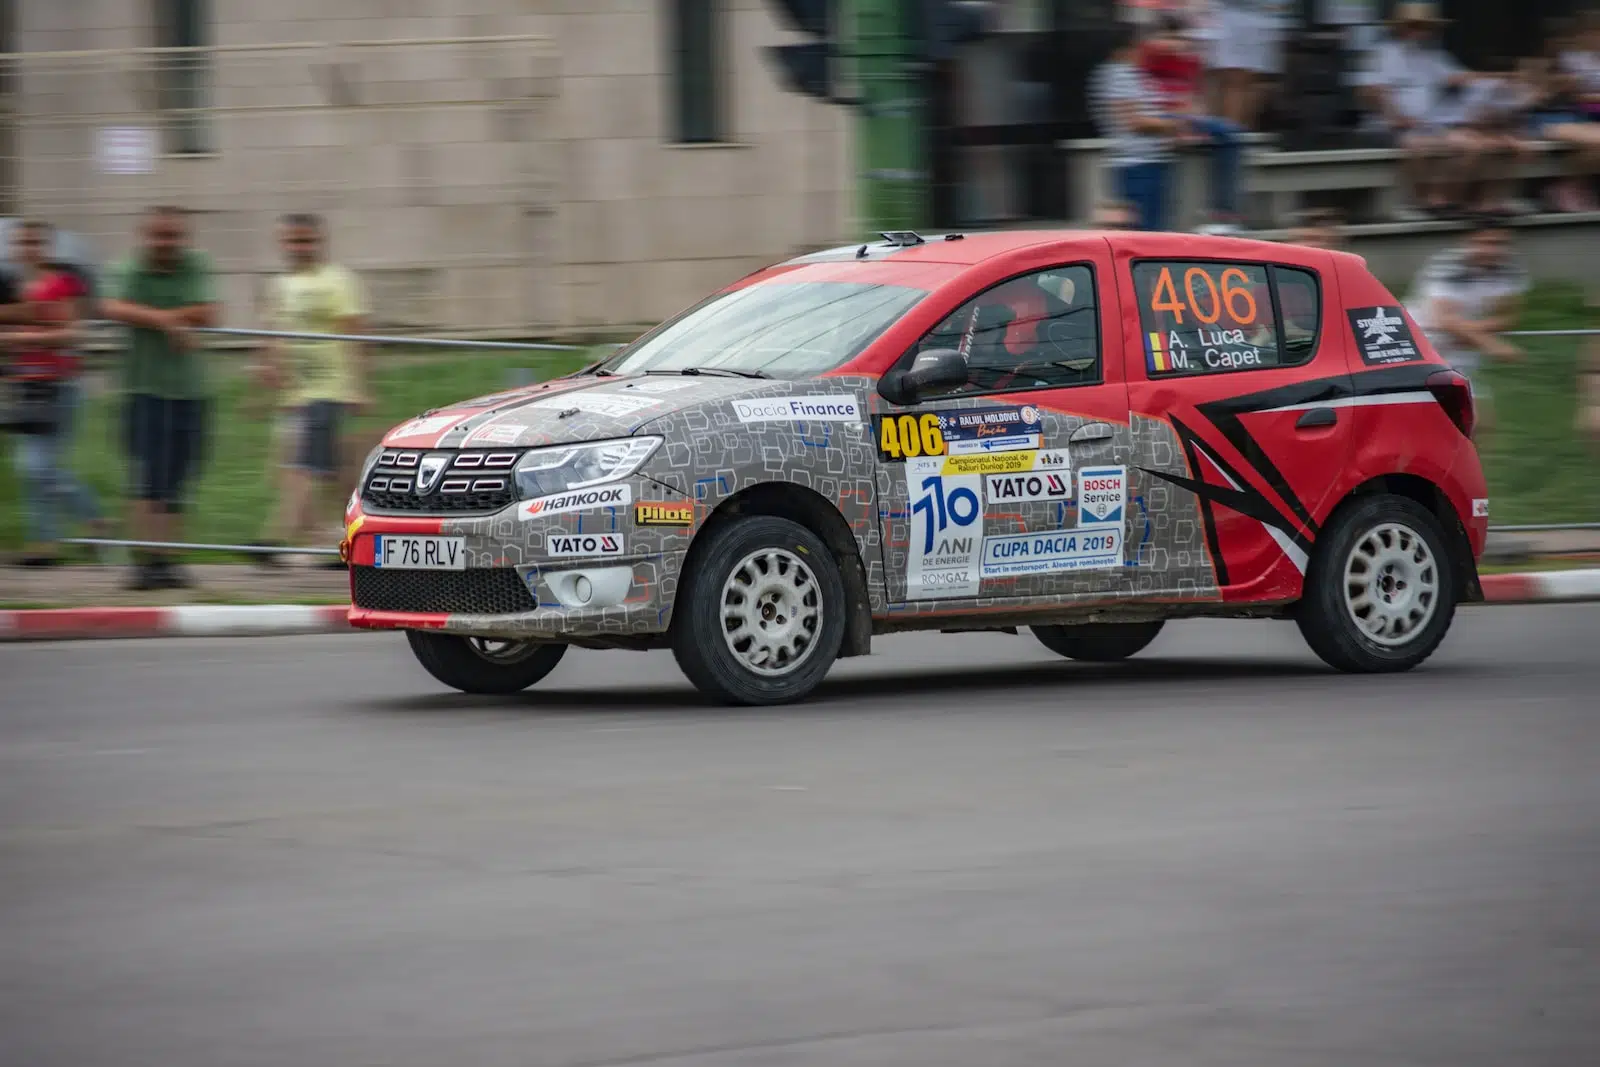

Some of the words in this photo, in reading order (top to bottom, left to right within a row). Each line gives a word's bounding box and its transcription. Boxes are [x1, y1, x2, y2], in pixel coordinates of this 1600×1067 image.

[1152, 267, 1257, 325] 406
[1169, 330, 1188, 349] A.
[1198, 328, 1245, 346] Luca
[1169, 350, 1194, 369] M.
[1205, 347, 1262, 368] Capet
[738, 404, 787, 418] Dacia
[789, 401, 854, 415] Finance
[984, 412, 1019, 424] MOLDOVEI
[881, 413, 944, 458] 406
[949, 455, 990, 467] Campionatul
[1019, 453, 1028, 461] de
[980, 462, 1003, 471] Dunlop
[1006, 461, 1021, 469] 2019
[991, 477, 1042, 498] YATO
[1084, 479, 1120, 491] BOSCH
[1084, 492, 1120, 503] Service
[384, 539, 396, 564] IF
[402, 540, 420, 565] 76
[426, 540, 457, 566] RLV
[552, 538, 597, 553] YATO
[937, 537, 972, 555] ANI
[992, 541, 1029, 558] CUPA
[1034, 537, 1076, 554] DACIA
[1082, 535, 1114, 551] 2019
[922, 557, 934, 566] DE
[935, 555, 970, 565] ENERGIE
[984, 566, 1001, 574] Start
[1011, 563, 1049, 572] motorsport.
[922, 571, 970, 584] ROMGAZ
